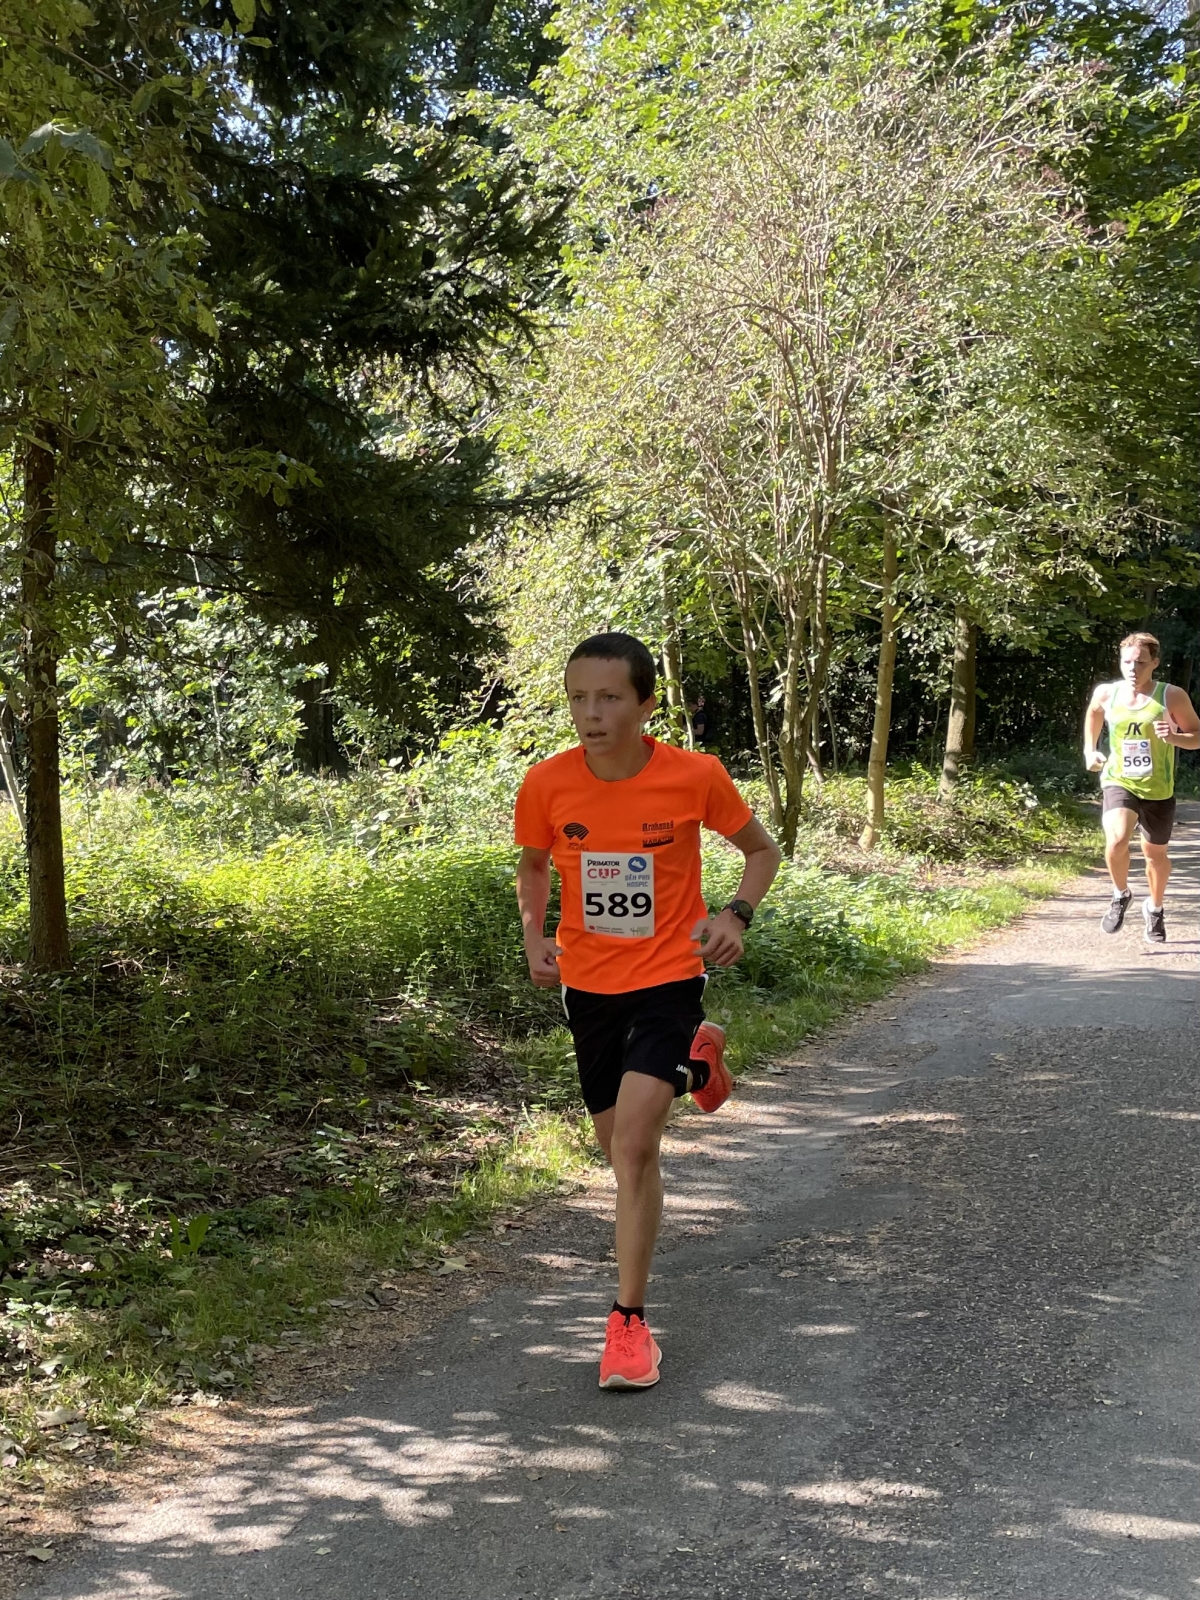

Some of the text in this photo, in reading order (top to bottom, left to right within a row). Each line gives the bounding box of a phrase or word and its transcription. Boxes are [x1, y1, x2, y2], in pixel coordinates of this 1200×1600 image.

[1123, 756, 1151, 767] 569
[587, 859, 620, 867] PRIMATOR
[587, 868, 620, 879] CUP
[585, 892, 652, 917] 589
